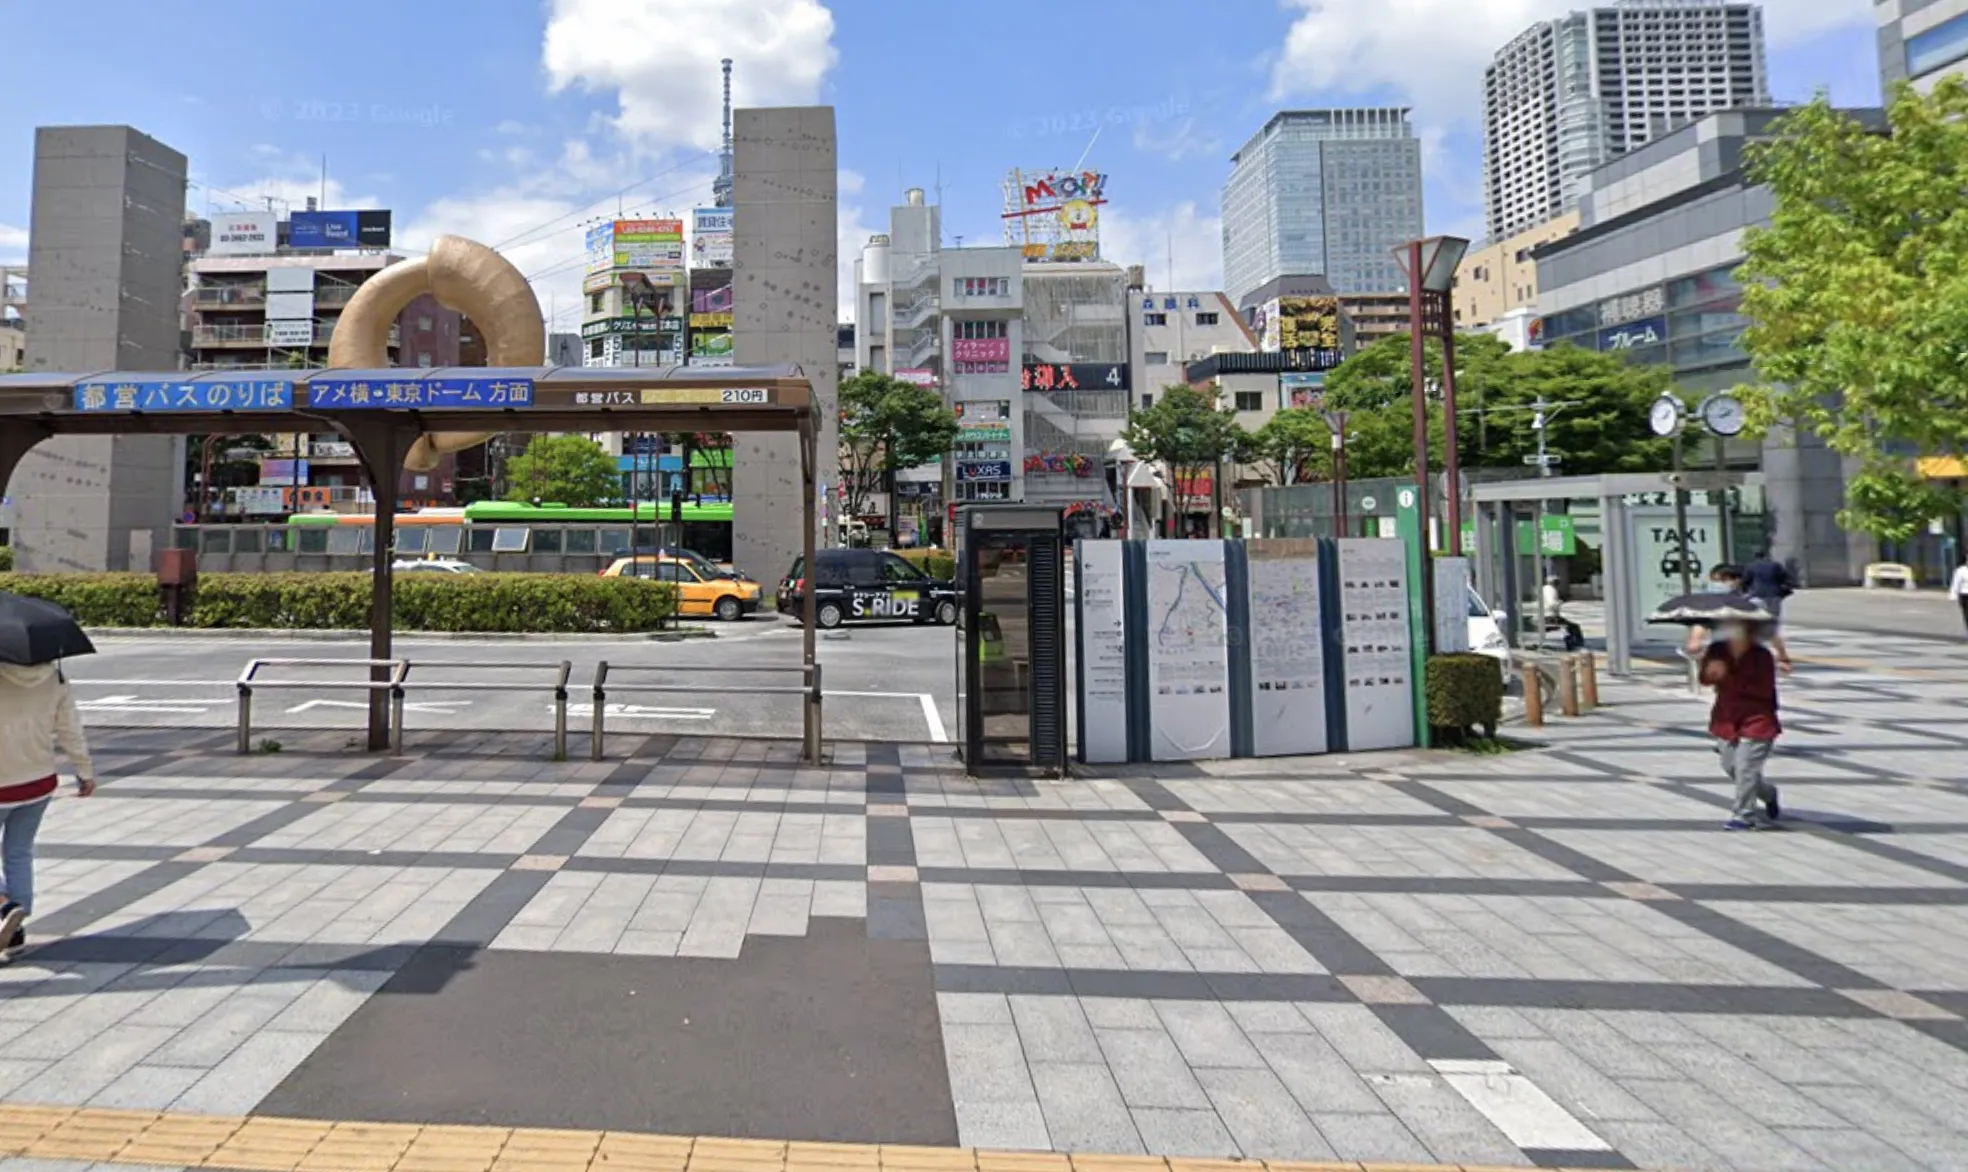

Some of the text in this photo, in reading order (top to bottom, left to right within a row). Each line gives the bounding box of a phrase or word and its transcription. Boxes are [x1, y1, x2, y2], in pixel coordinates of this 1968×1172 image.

[1106, 366, 1121, 386] 4
[82, 382, 285, 409] 都営バスのりば
[575, 391, 635, 405] 都営バス
[723, 389, 764, 402] 210円
[1651, 528, 1706, 543] TAXI
